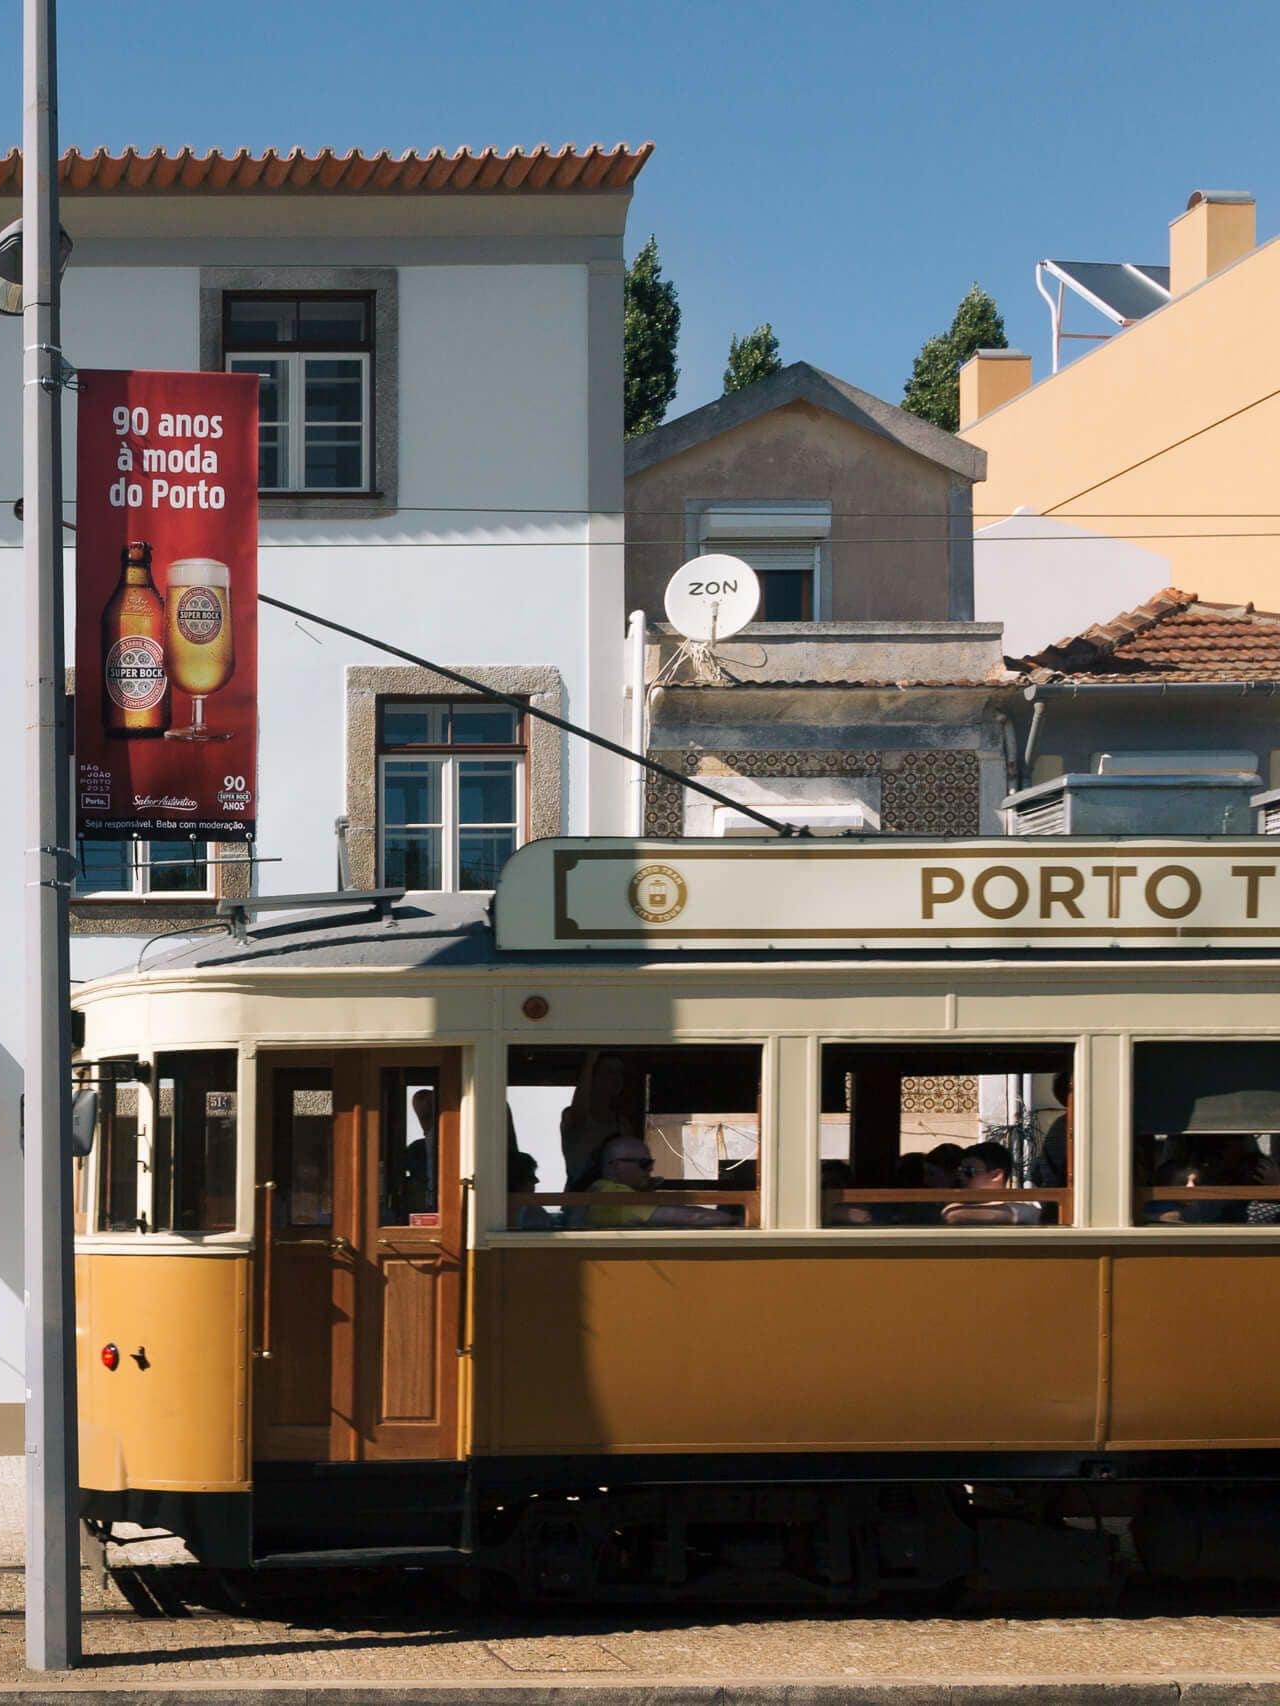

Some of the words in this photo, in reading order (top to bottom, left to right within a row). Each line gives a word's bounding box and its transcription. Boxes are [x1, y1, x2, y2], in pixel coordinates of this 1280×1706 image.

[112, 406, 150, 436] 90
[158, 413, 223, 439] anos
[117, 442, 132, 472] à
[143, 443, 218, 474] moda
[109, 477, 143, 507] do
[152, 479, 225, 509] Porto
[689, 579, 738, 596] ZON
[180, 611, 201, 619] SUPER
[202, 611, 220, 619] BOCK
[110, 668, 138, 678] SUPER
[139, 668, 163, 678] BOCK
[223, 775, 245, 791] 90
[132, 794, 159, 806] Sabor
[222, 802, 245, 811] ANOS
[85, 820, 103, 830] Seja
[156, 820, 177, 828] Beba
[199, 821, 246, 831] moderação.
[633, 866, 659, 884] PORTO
[661, 867, 683, 885] TRAM
[920, 864, 1202, 920] PORTO
[633, 904, 655, 921] CITY
[658, 904, 682, 921] TOUR
